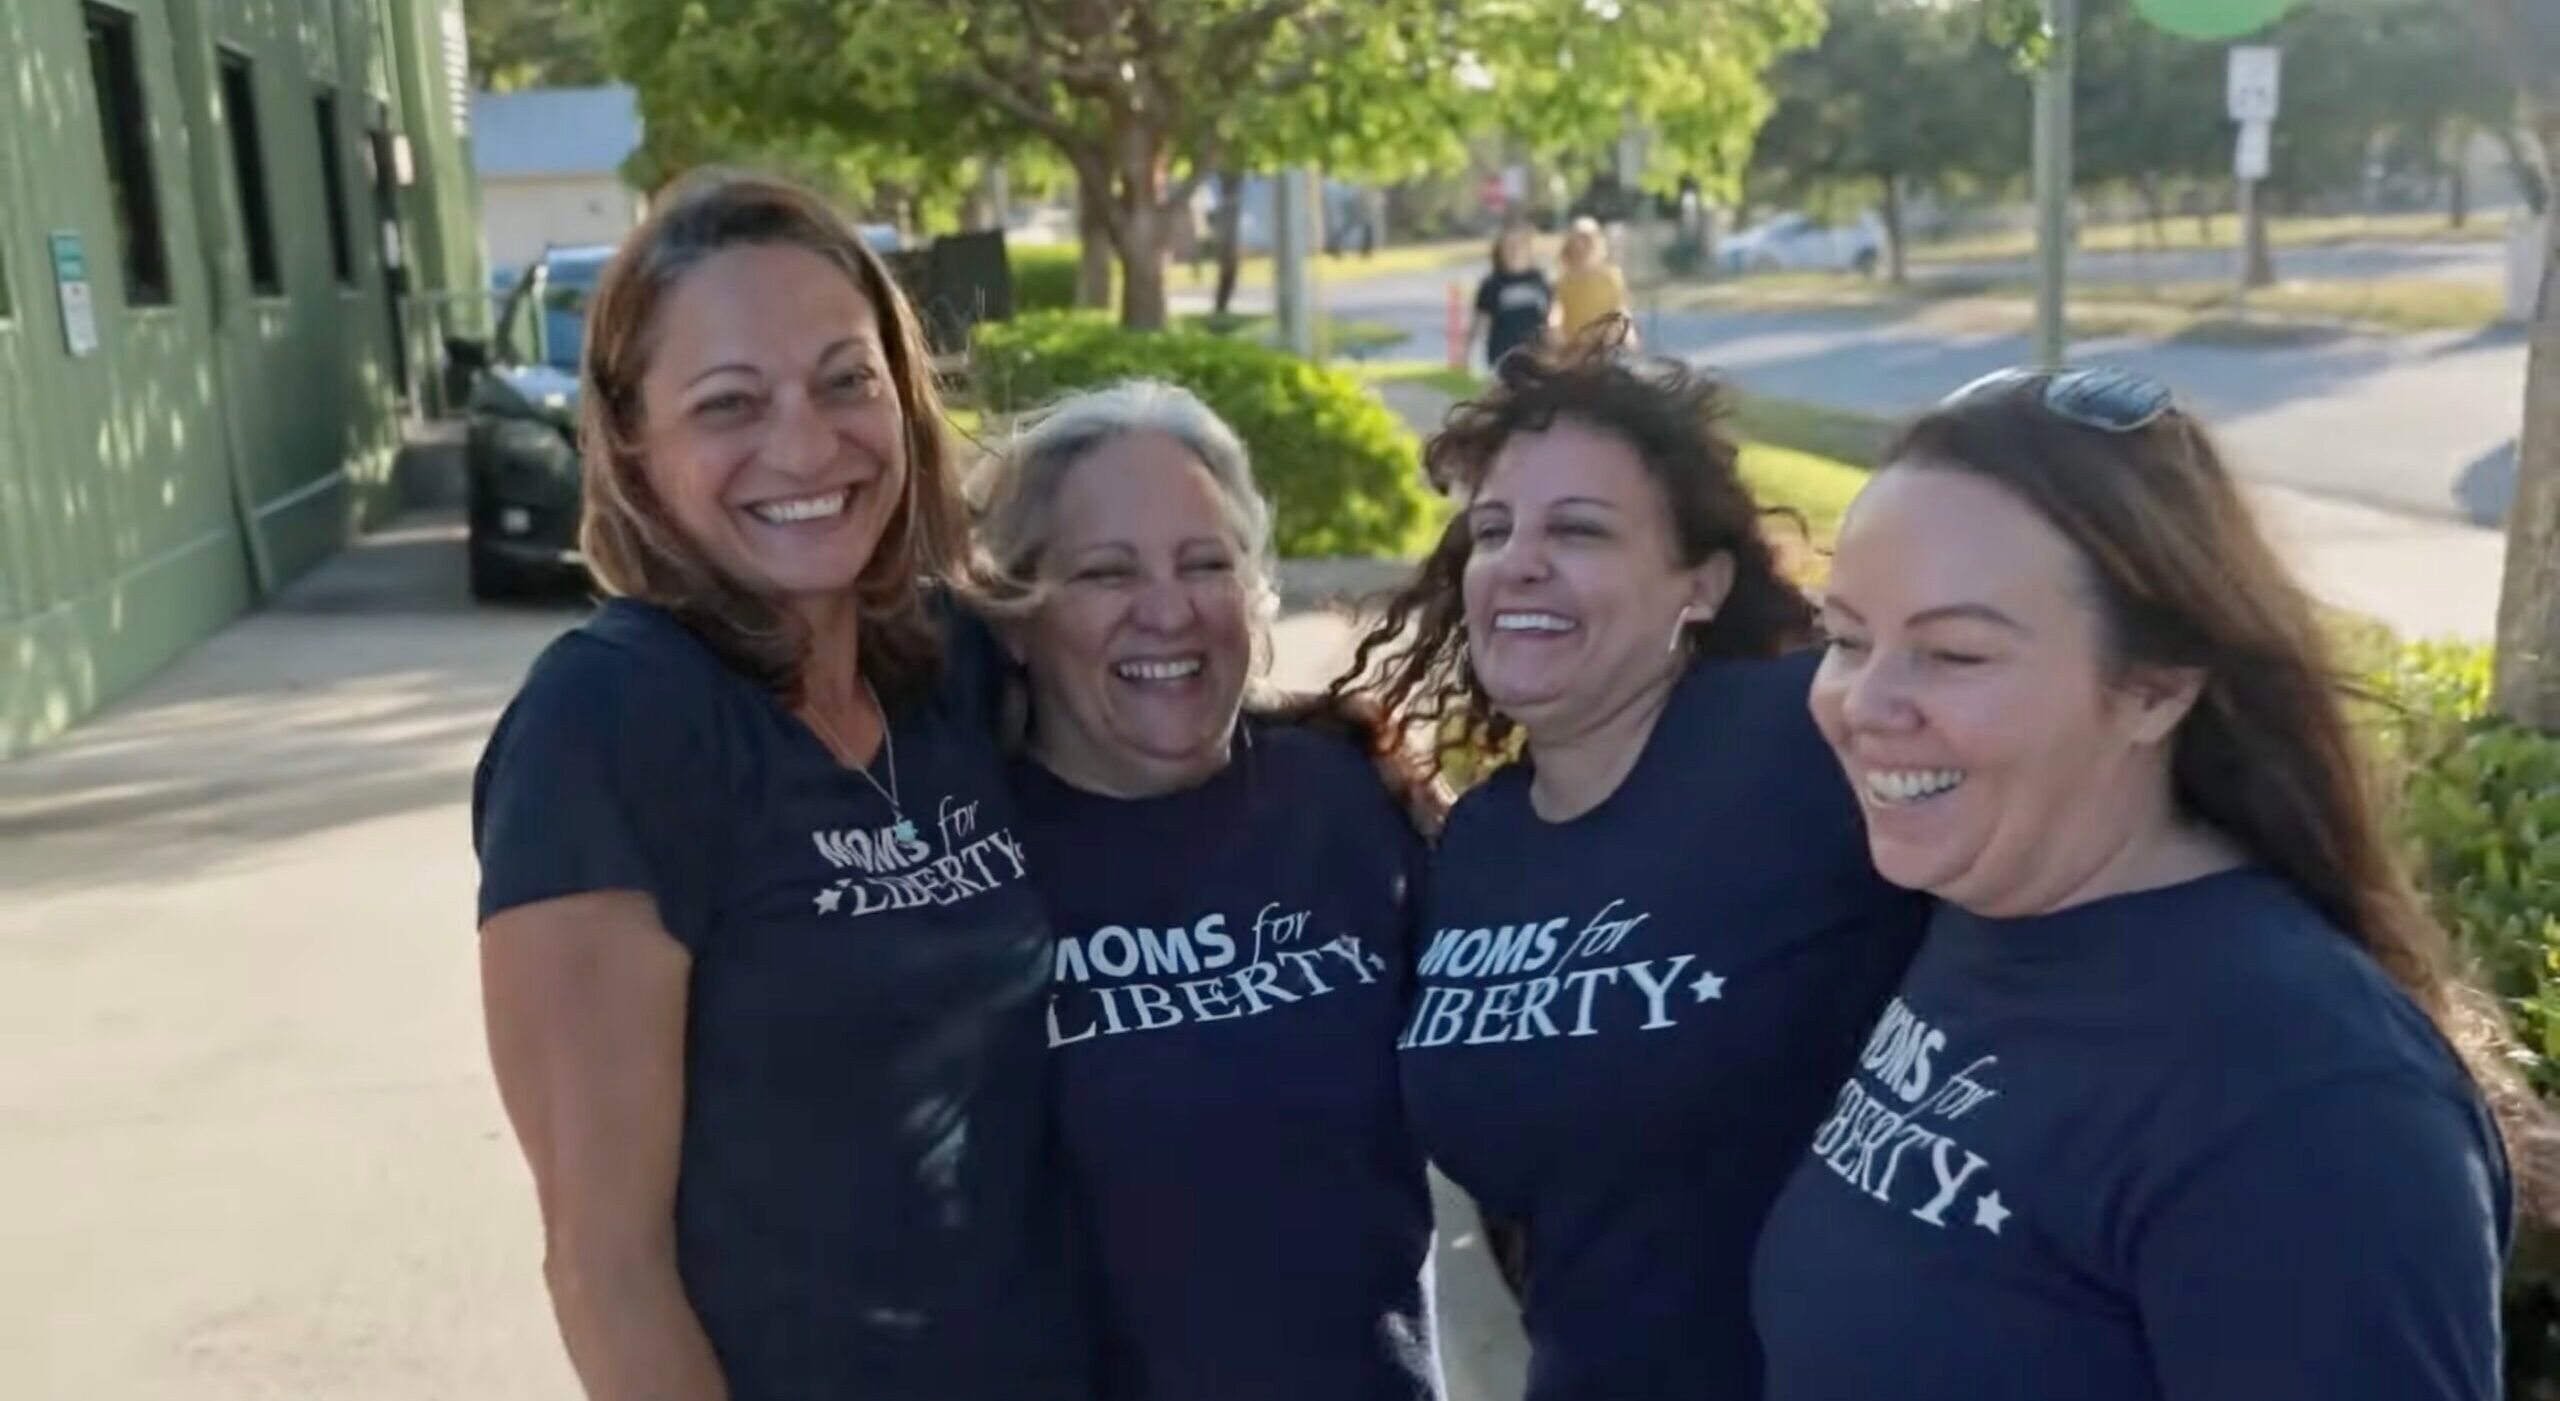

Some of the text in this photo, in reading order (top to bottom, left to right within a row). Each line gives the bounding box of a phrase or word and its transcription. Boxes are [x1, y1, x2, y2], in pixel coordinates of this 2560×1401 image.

[938, 796, 978, 858] for
[851, 827, 1025, 916] LIBERTY
[1252, 902, 1312, 971] for
[1416, 899, 1650, 978] MOMS for
[1047, 934, 1376, 1049] LIBERTY
[1396, 954, 1696, 1050] IBERTY
[1901, 1055, 1998, 1121] for
